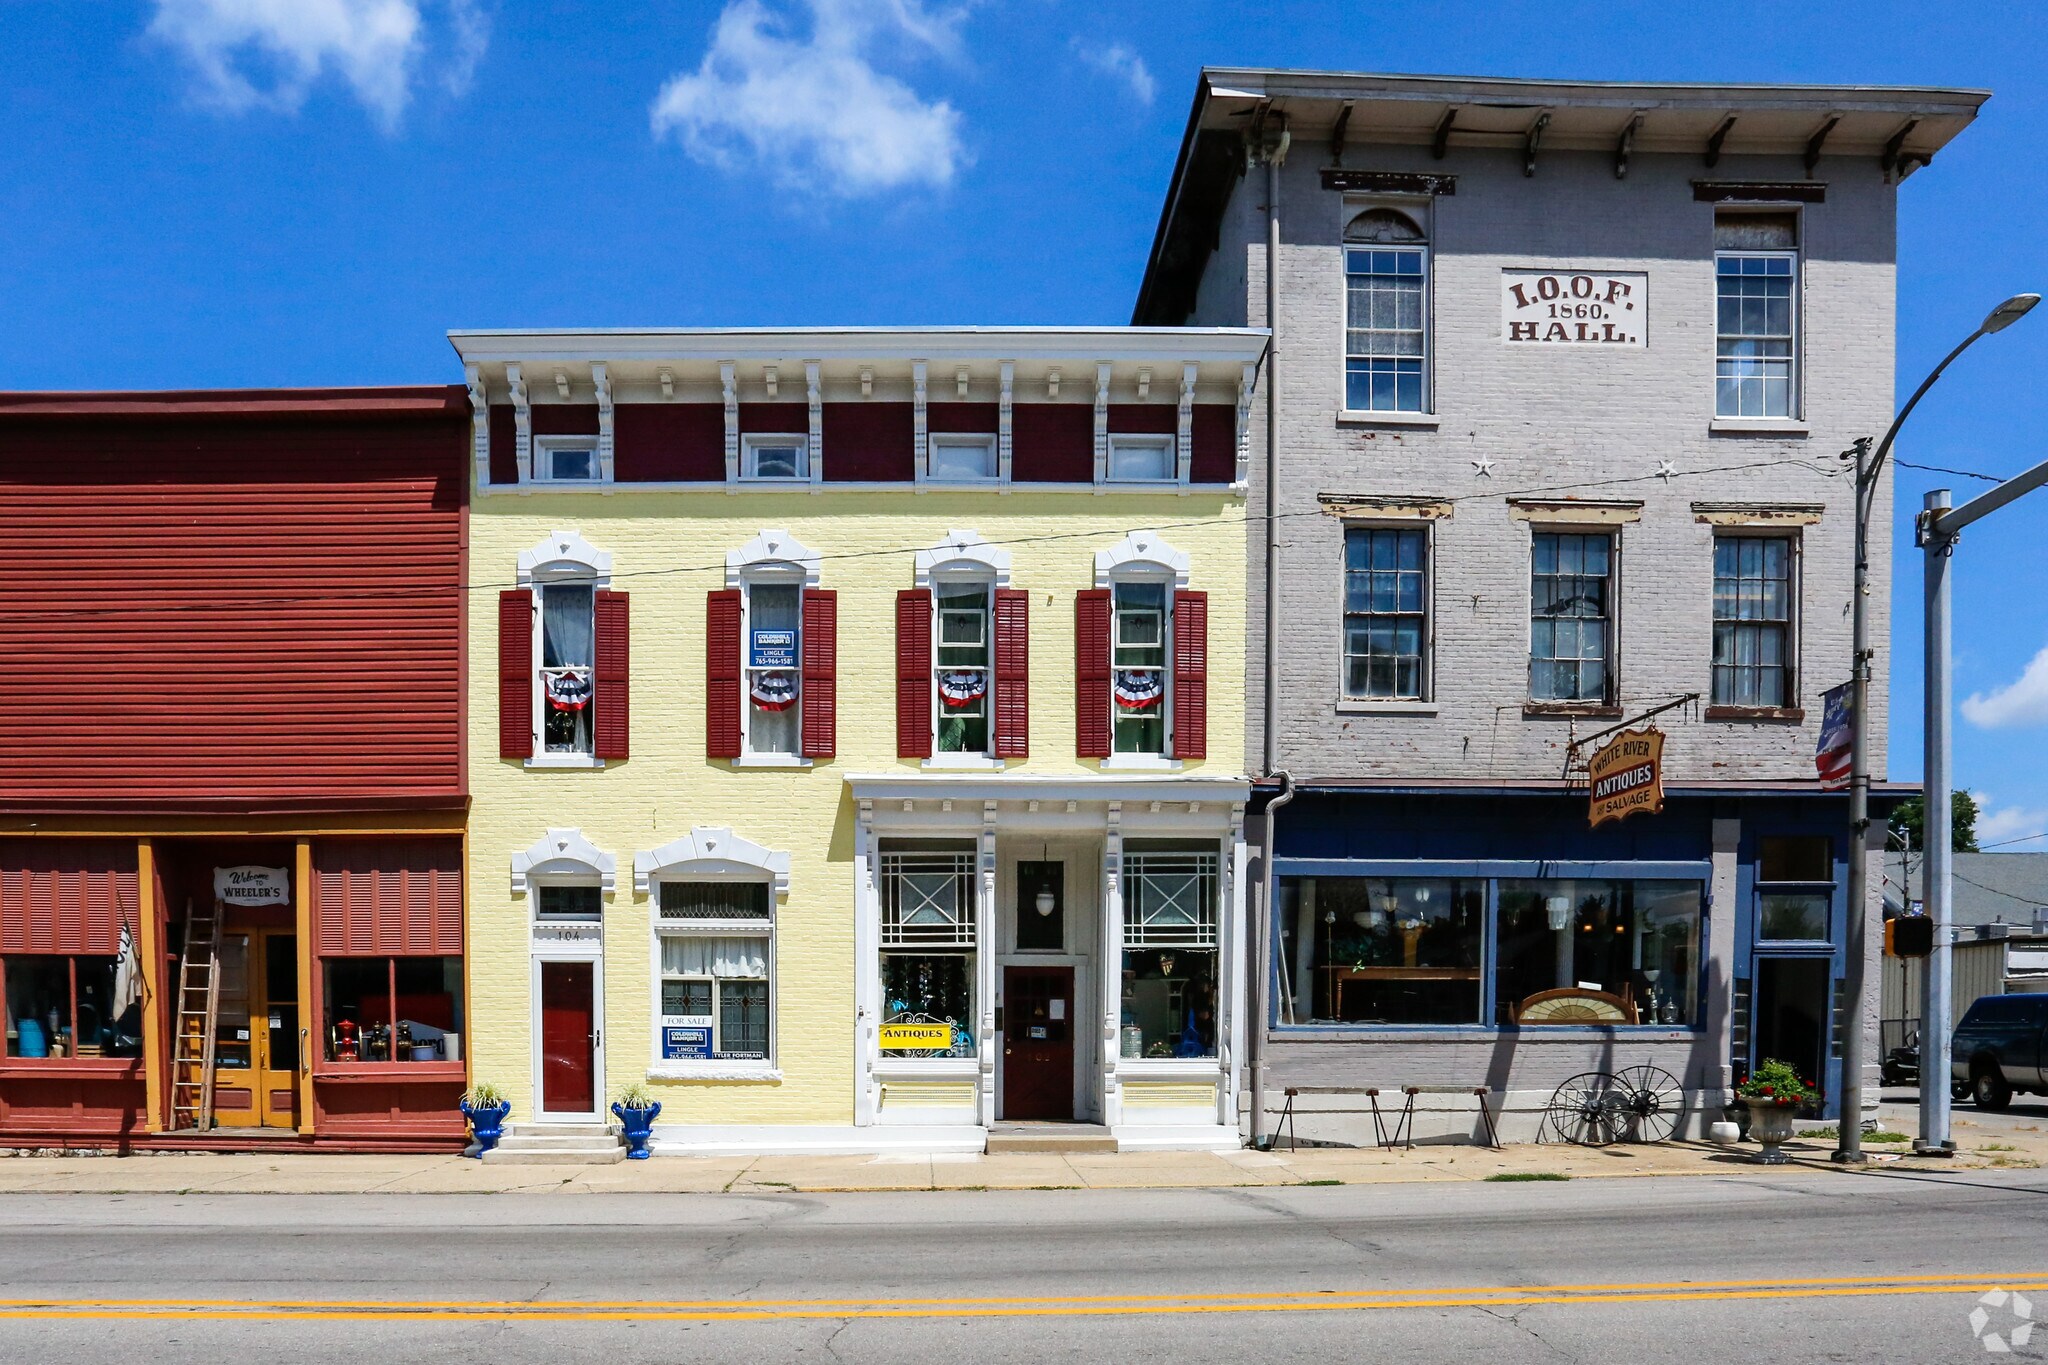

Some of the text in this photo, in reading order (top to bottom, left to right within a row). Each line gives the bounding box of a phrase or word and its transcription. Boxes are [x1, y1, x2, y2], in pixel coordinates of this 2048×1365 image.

[1509, 276, 1634, 311] I.O.O.F.
[1548, 303, 1609, 319] 1860.
[1509, 321, 1636, 343] HALL.
[755, 657, 793, 665] 765-966-1581
[1594, 741, 1650, 774] WHITE RIVER
[1595, 764, 1652, 798] ANTIQUES
[1606, 790, 1651, 813] SALVAGE
[229, 870, 269, 884] Welcome
[224, 886, 280, 897] WHEELER'S
[558, 931, 580, 941] 104
[884, 1029, 943, 1039] ANTIQUES
